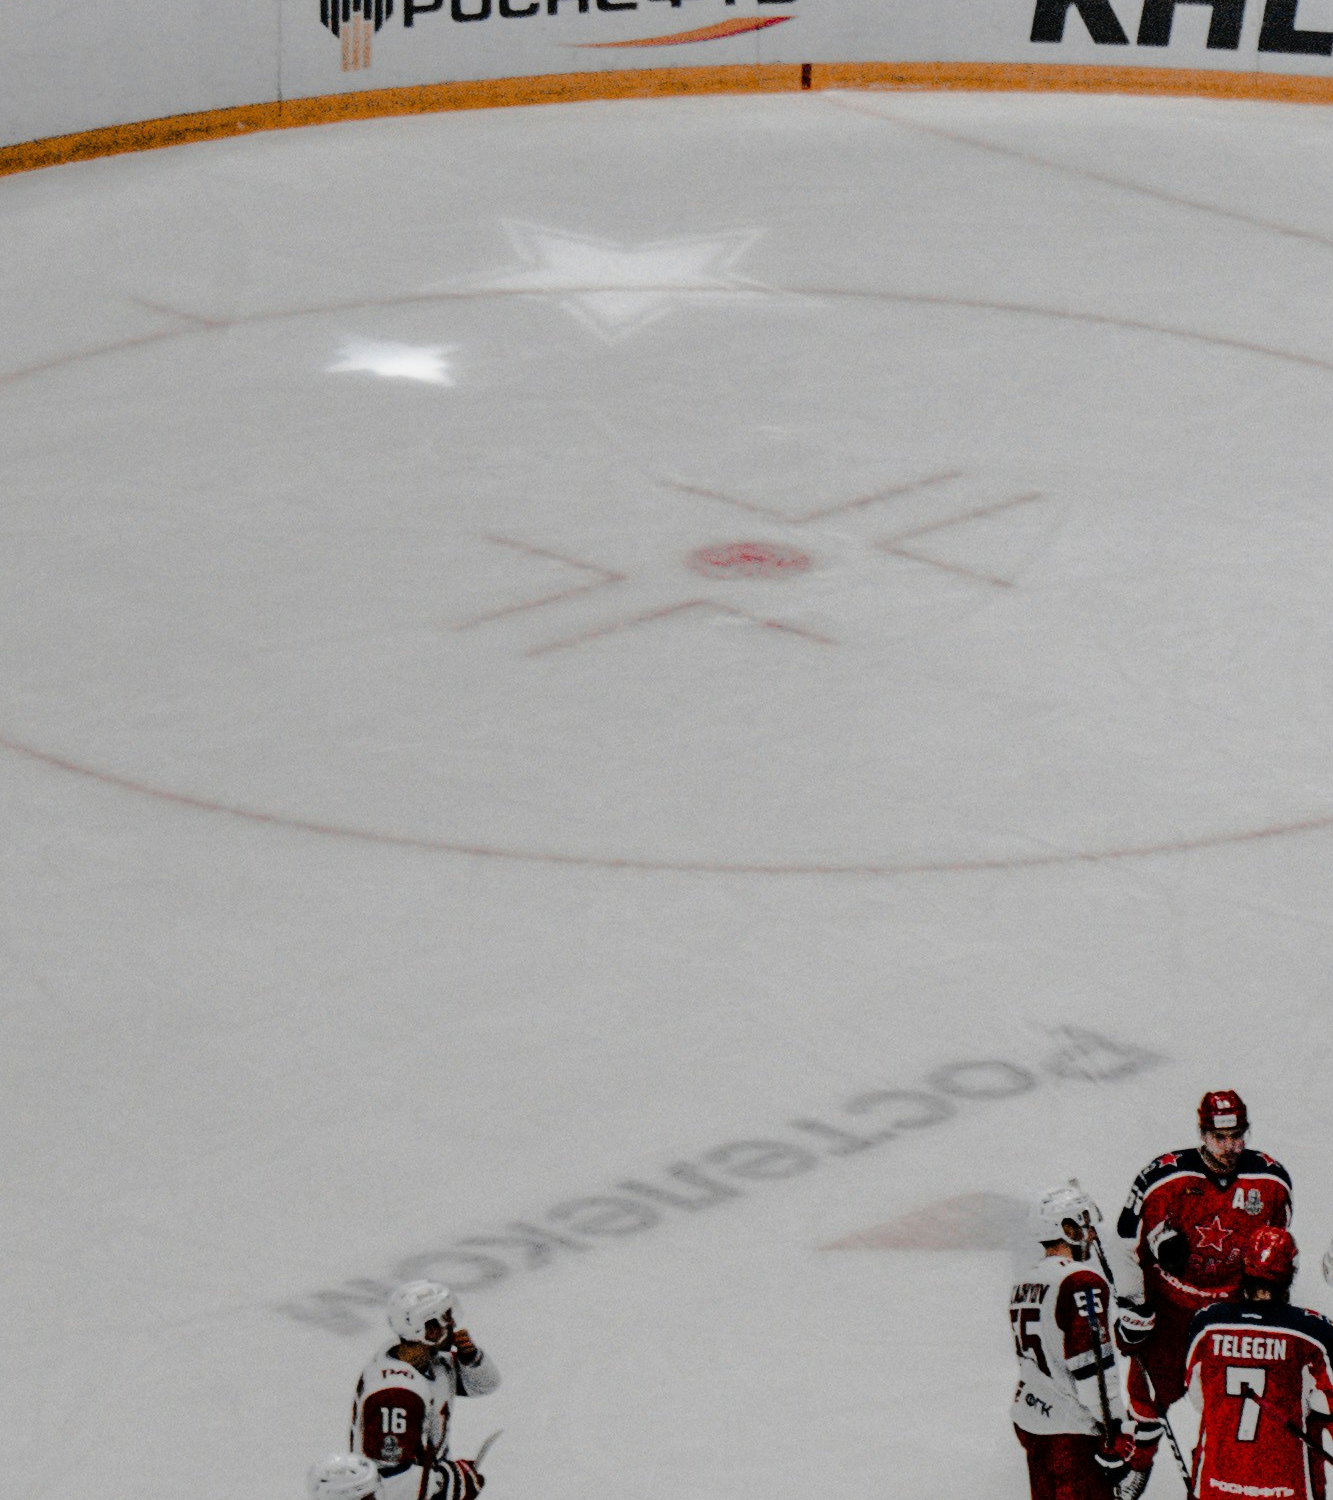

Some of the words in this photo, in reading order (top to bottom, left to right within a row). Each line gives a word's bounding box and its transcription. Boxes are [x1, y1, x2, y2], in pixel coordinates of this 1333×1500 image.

[1210, 1333, 1288, 1362] TELEGIN
[1224, 1364, 1268, 1443] 7
[379, 1406, 408, 1435] 16
